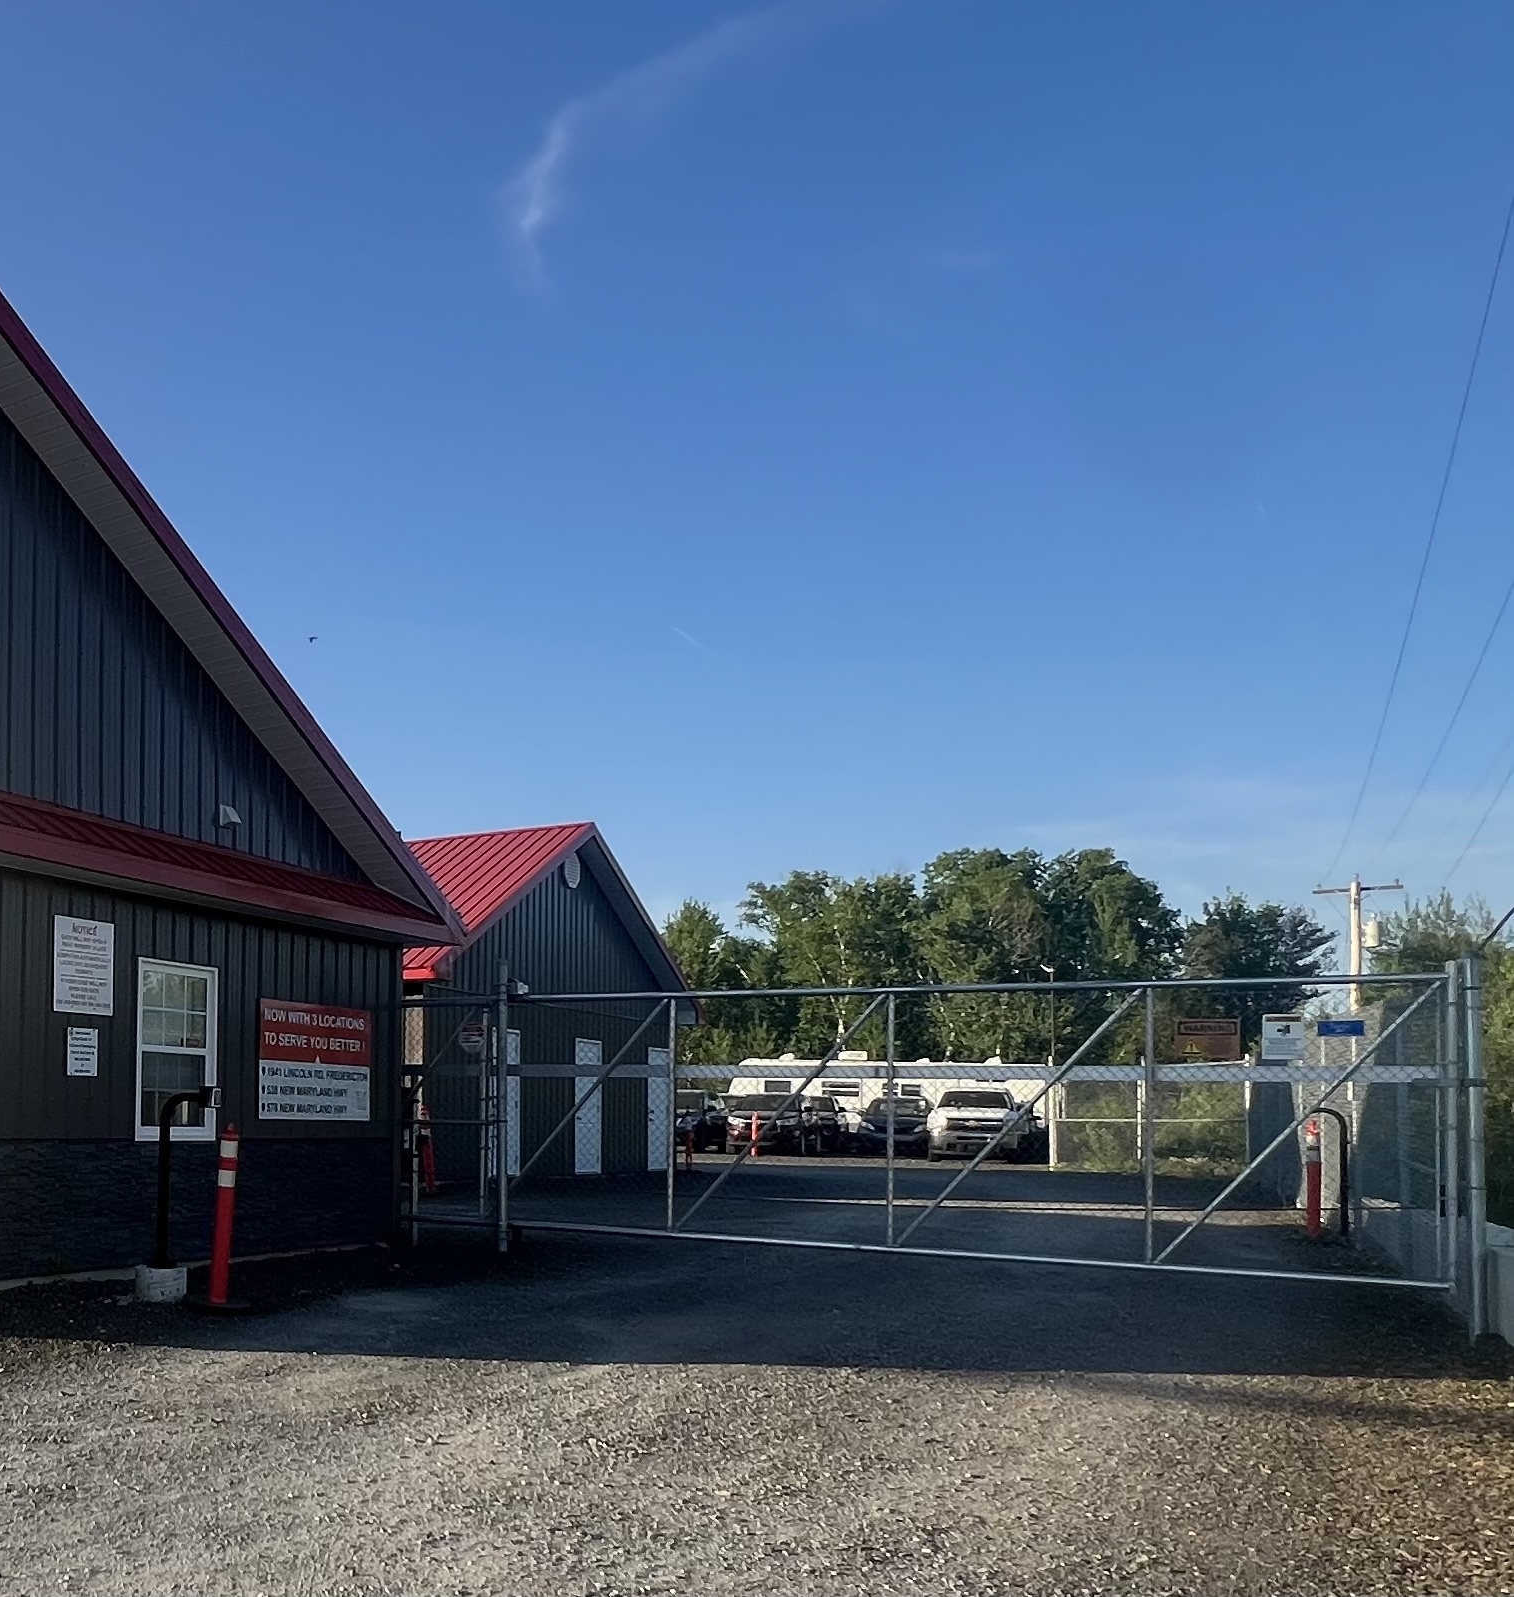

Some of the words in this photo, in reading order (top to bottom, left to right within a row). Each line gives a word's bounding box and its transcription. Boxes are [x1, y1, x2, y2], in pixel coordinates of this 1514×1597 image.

[263, 1008, 286, 1023] NOW
[287, 1011, 311, 1026] WITH
[311, 1013, 317, 1026] 3
[318, 1014, 365, 1031] LOCATIONS
[263, 1031, 277, 1046] TO
[278, 1033, 308, 1048] SERVE
[309, 1036, 327, 1050] YOU
[329, 1037, 361, 1053] BETTER
